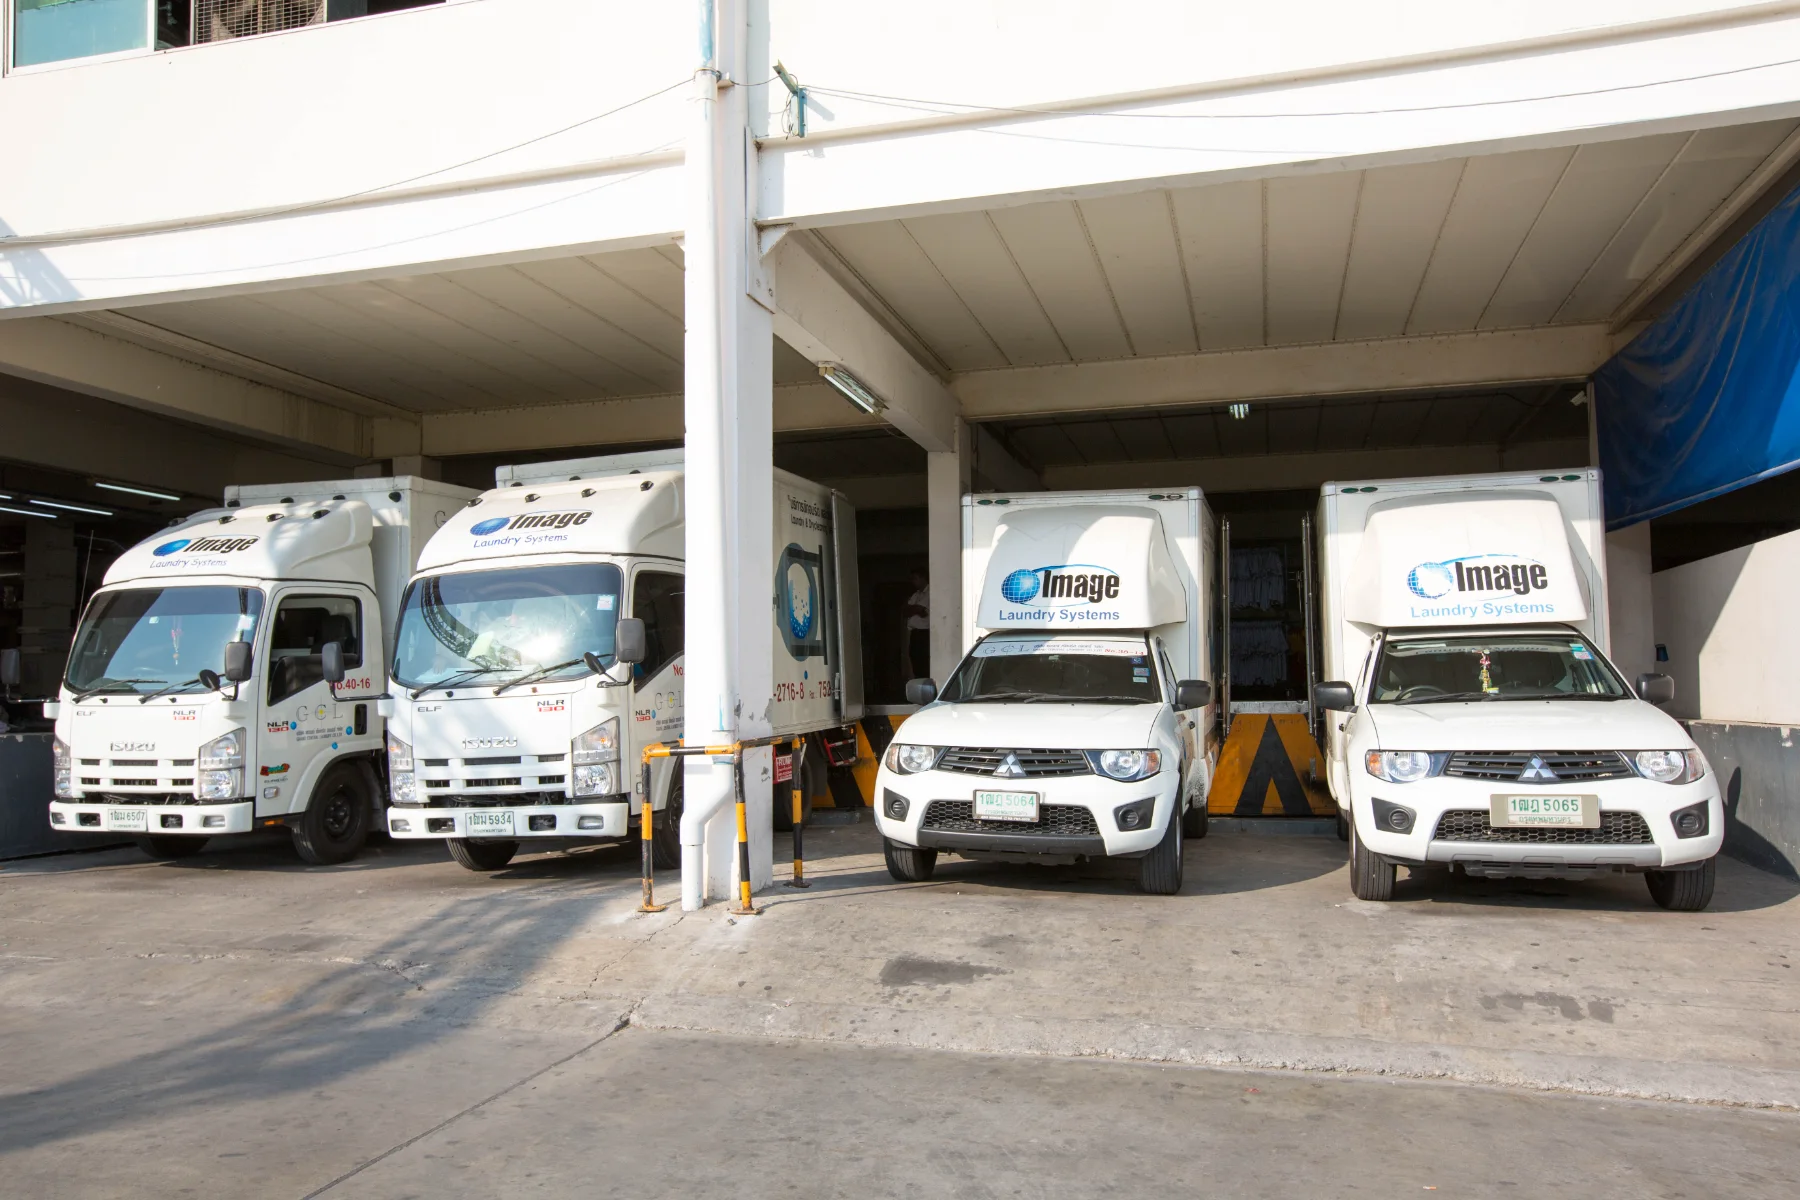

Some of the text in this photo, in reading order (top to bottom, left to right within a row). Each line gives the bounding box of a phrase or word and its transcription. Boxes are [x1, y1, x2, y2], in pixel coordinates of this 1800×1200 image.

[508, 511, 593, 529] Image
[183, 537, 259, 553] Image
[473, 534, 568, 548] Laundry Systems
[150, 558, 228, 568] Laundry Systems
[1455, 561, 1548, 595] Image
[1042, 570, 1120, 603] Image
[999, 609, 1120, 622] Laundry Systems
[1411, 602, 1554, 618] Laundry Systems
[329, 678, 371, 690] o.40-16
[110, 742, 156, 751] ISUZU
[462, 736, 518, 749] ISUZU
[1006, 794, 1035, 807] 5064
[1543, 799, 1579, 812] 5065
[126, 811, 145, 821] 6507
[488, 813, 512, 825] 5934
